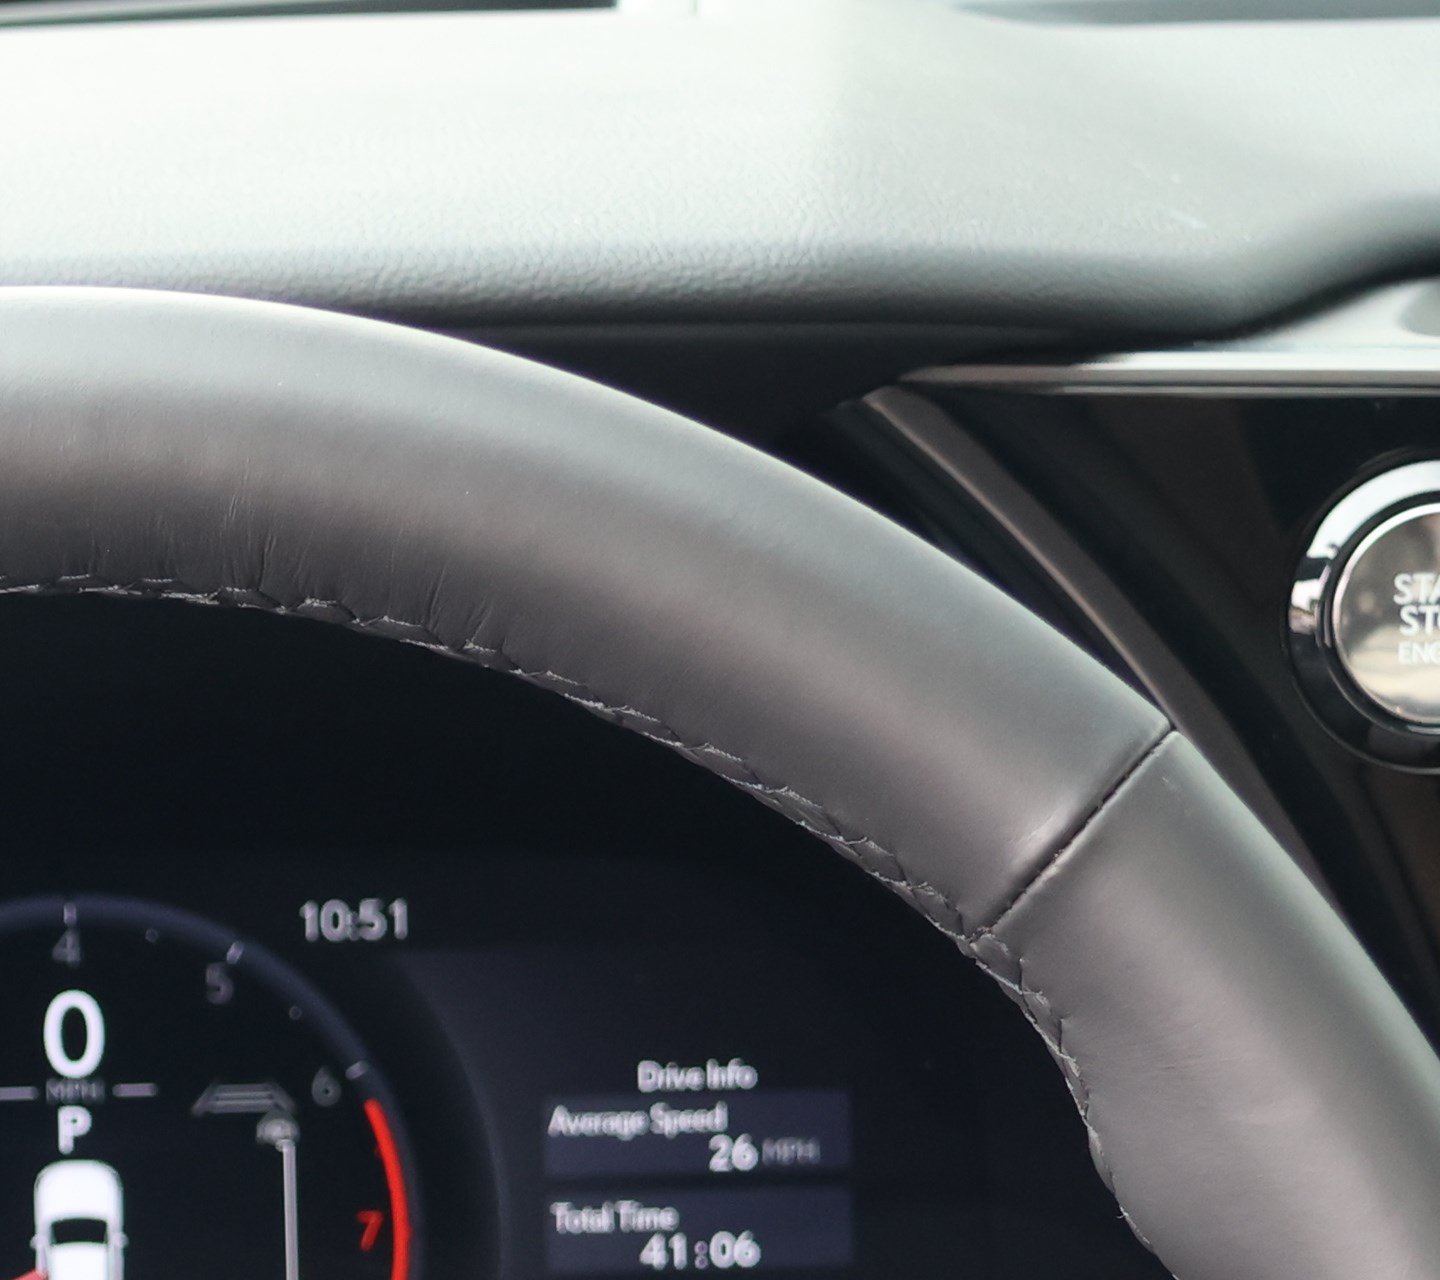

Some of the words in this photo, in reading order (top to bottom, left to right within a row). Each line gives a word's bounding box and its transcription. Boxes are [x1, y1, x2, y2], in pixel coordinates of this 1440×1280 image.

[299, 898, 409, 943] 10:51
[52, 928, 82, 968] 4
[43, 989, 106, 1080] 0
[637, 1059, 706, 1093] Drive
[706, 1057, 759, 1091] Info
[56, 1105, 93, 1155] P
[547, 1104, 650, 1142] Average
[650, 1099, 730, 1140] Speed
[708, 1133, 759, 1172] 26
[355, 1209, 384, 1252] 7
[549, 1201, 616, 1234] Total
[615, 1199, 681, 1233] Time
[639, 1230, 762, 1270] 41:06
